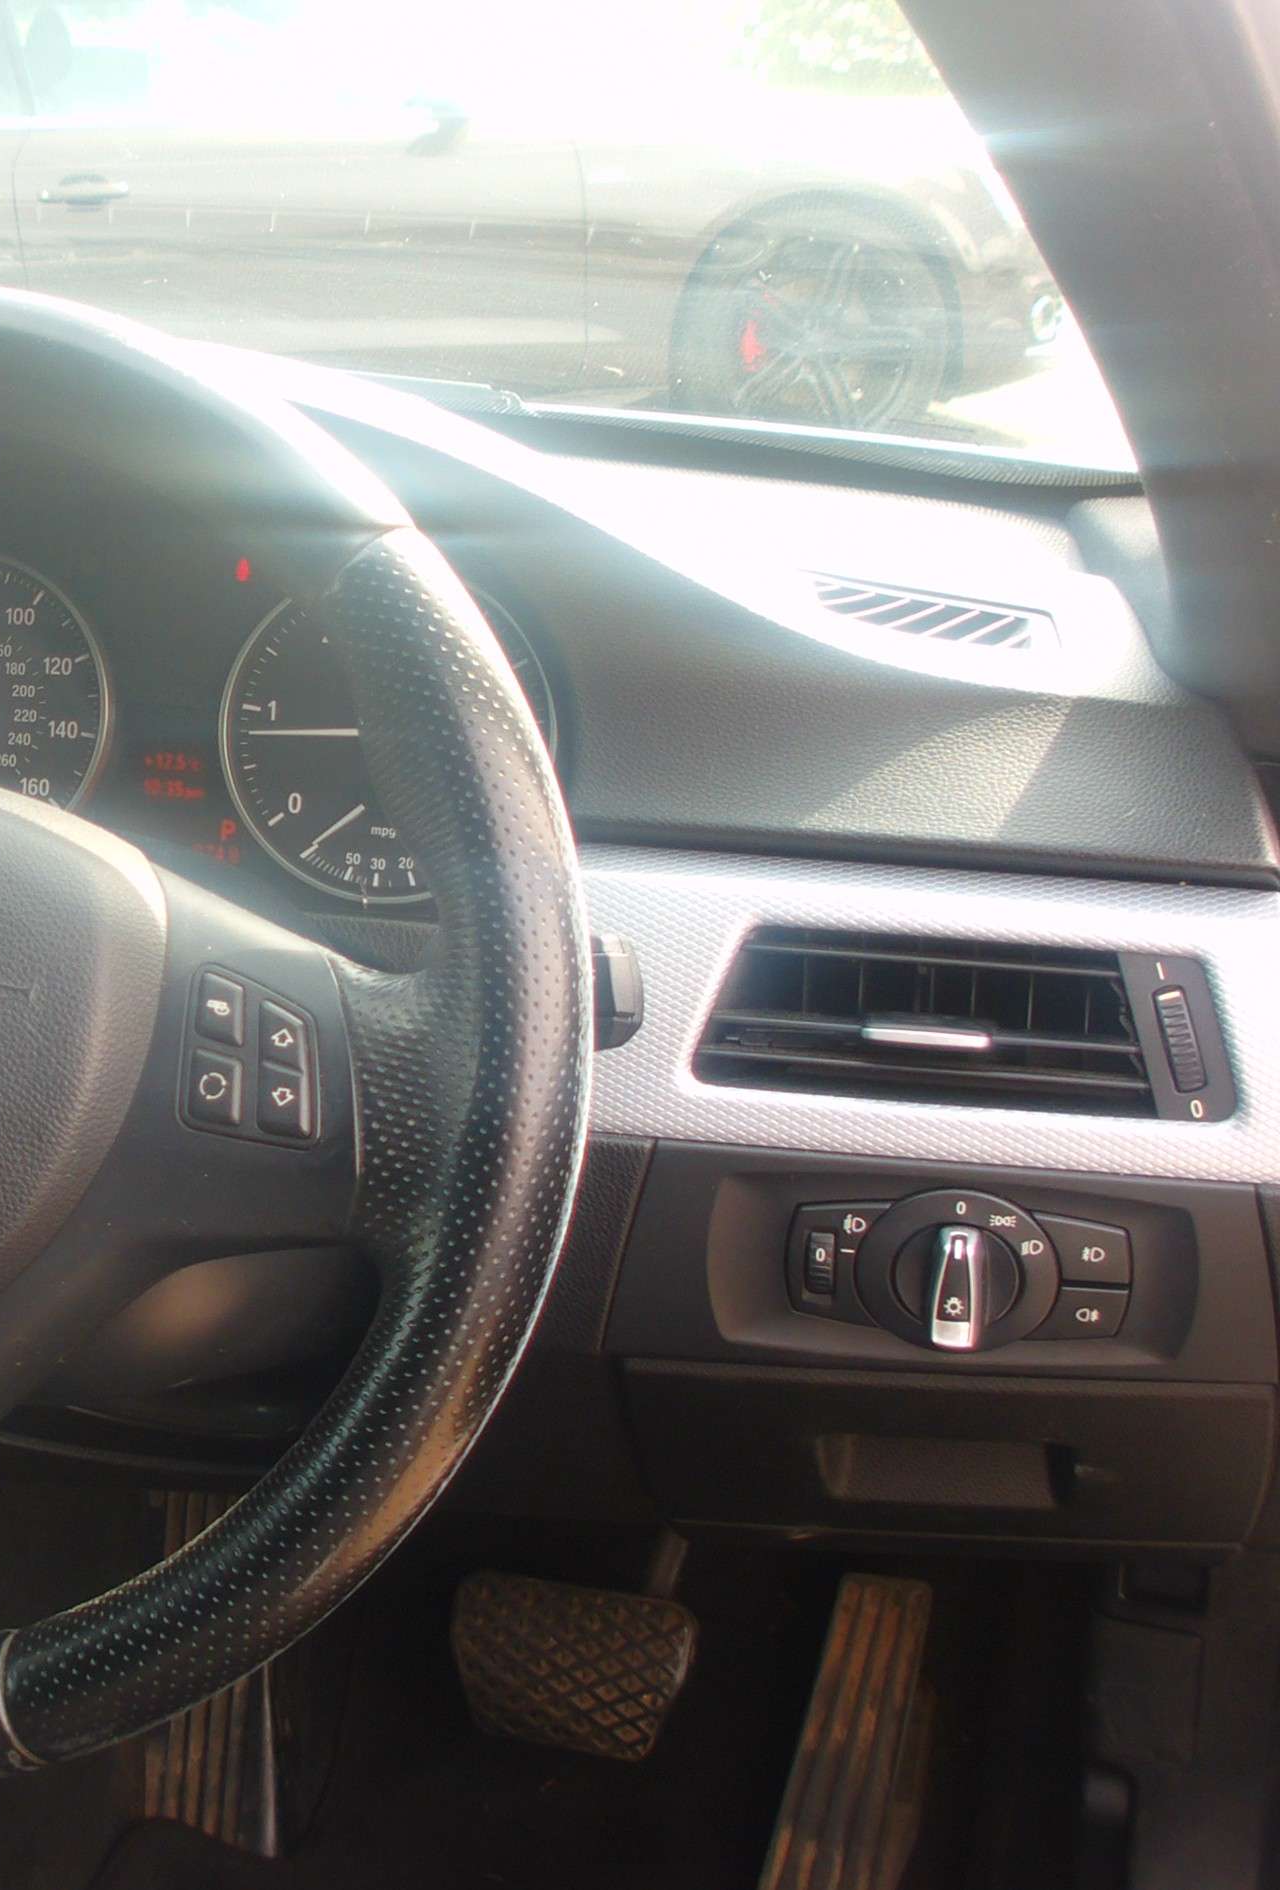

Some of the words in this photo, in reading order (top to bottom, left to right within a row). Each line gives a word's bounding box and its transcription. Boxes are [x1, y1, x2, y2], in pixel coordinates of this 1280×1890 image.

[6, 607, 36, 626] 100
[6, 662, 26, 676] 180
[43, 657, 72, 676] 120
[12, 685, 36, 699] 200
[14, 710, 38, 724] 220
[267, 700, 277, 721] 1
[48, 721, 78, 739] 140
[8, 732, 31, 747] 240
[20, 778, 51, 797] 160
[287, 792, 303, 815] 0
[221, 819, 237, 840] P
[370, 825, 397, 840] mpg
[345, 852, 361, 865] 50
[369, 857, 386, 870] 30
[398, 856, 415, 870] 20
